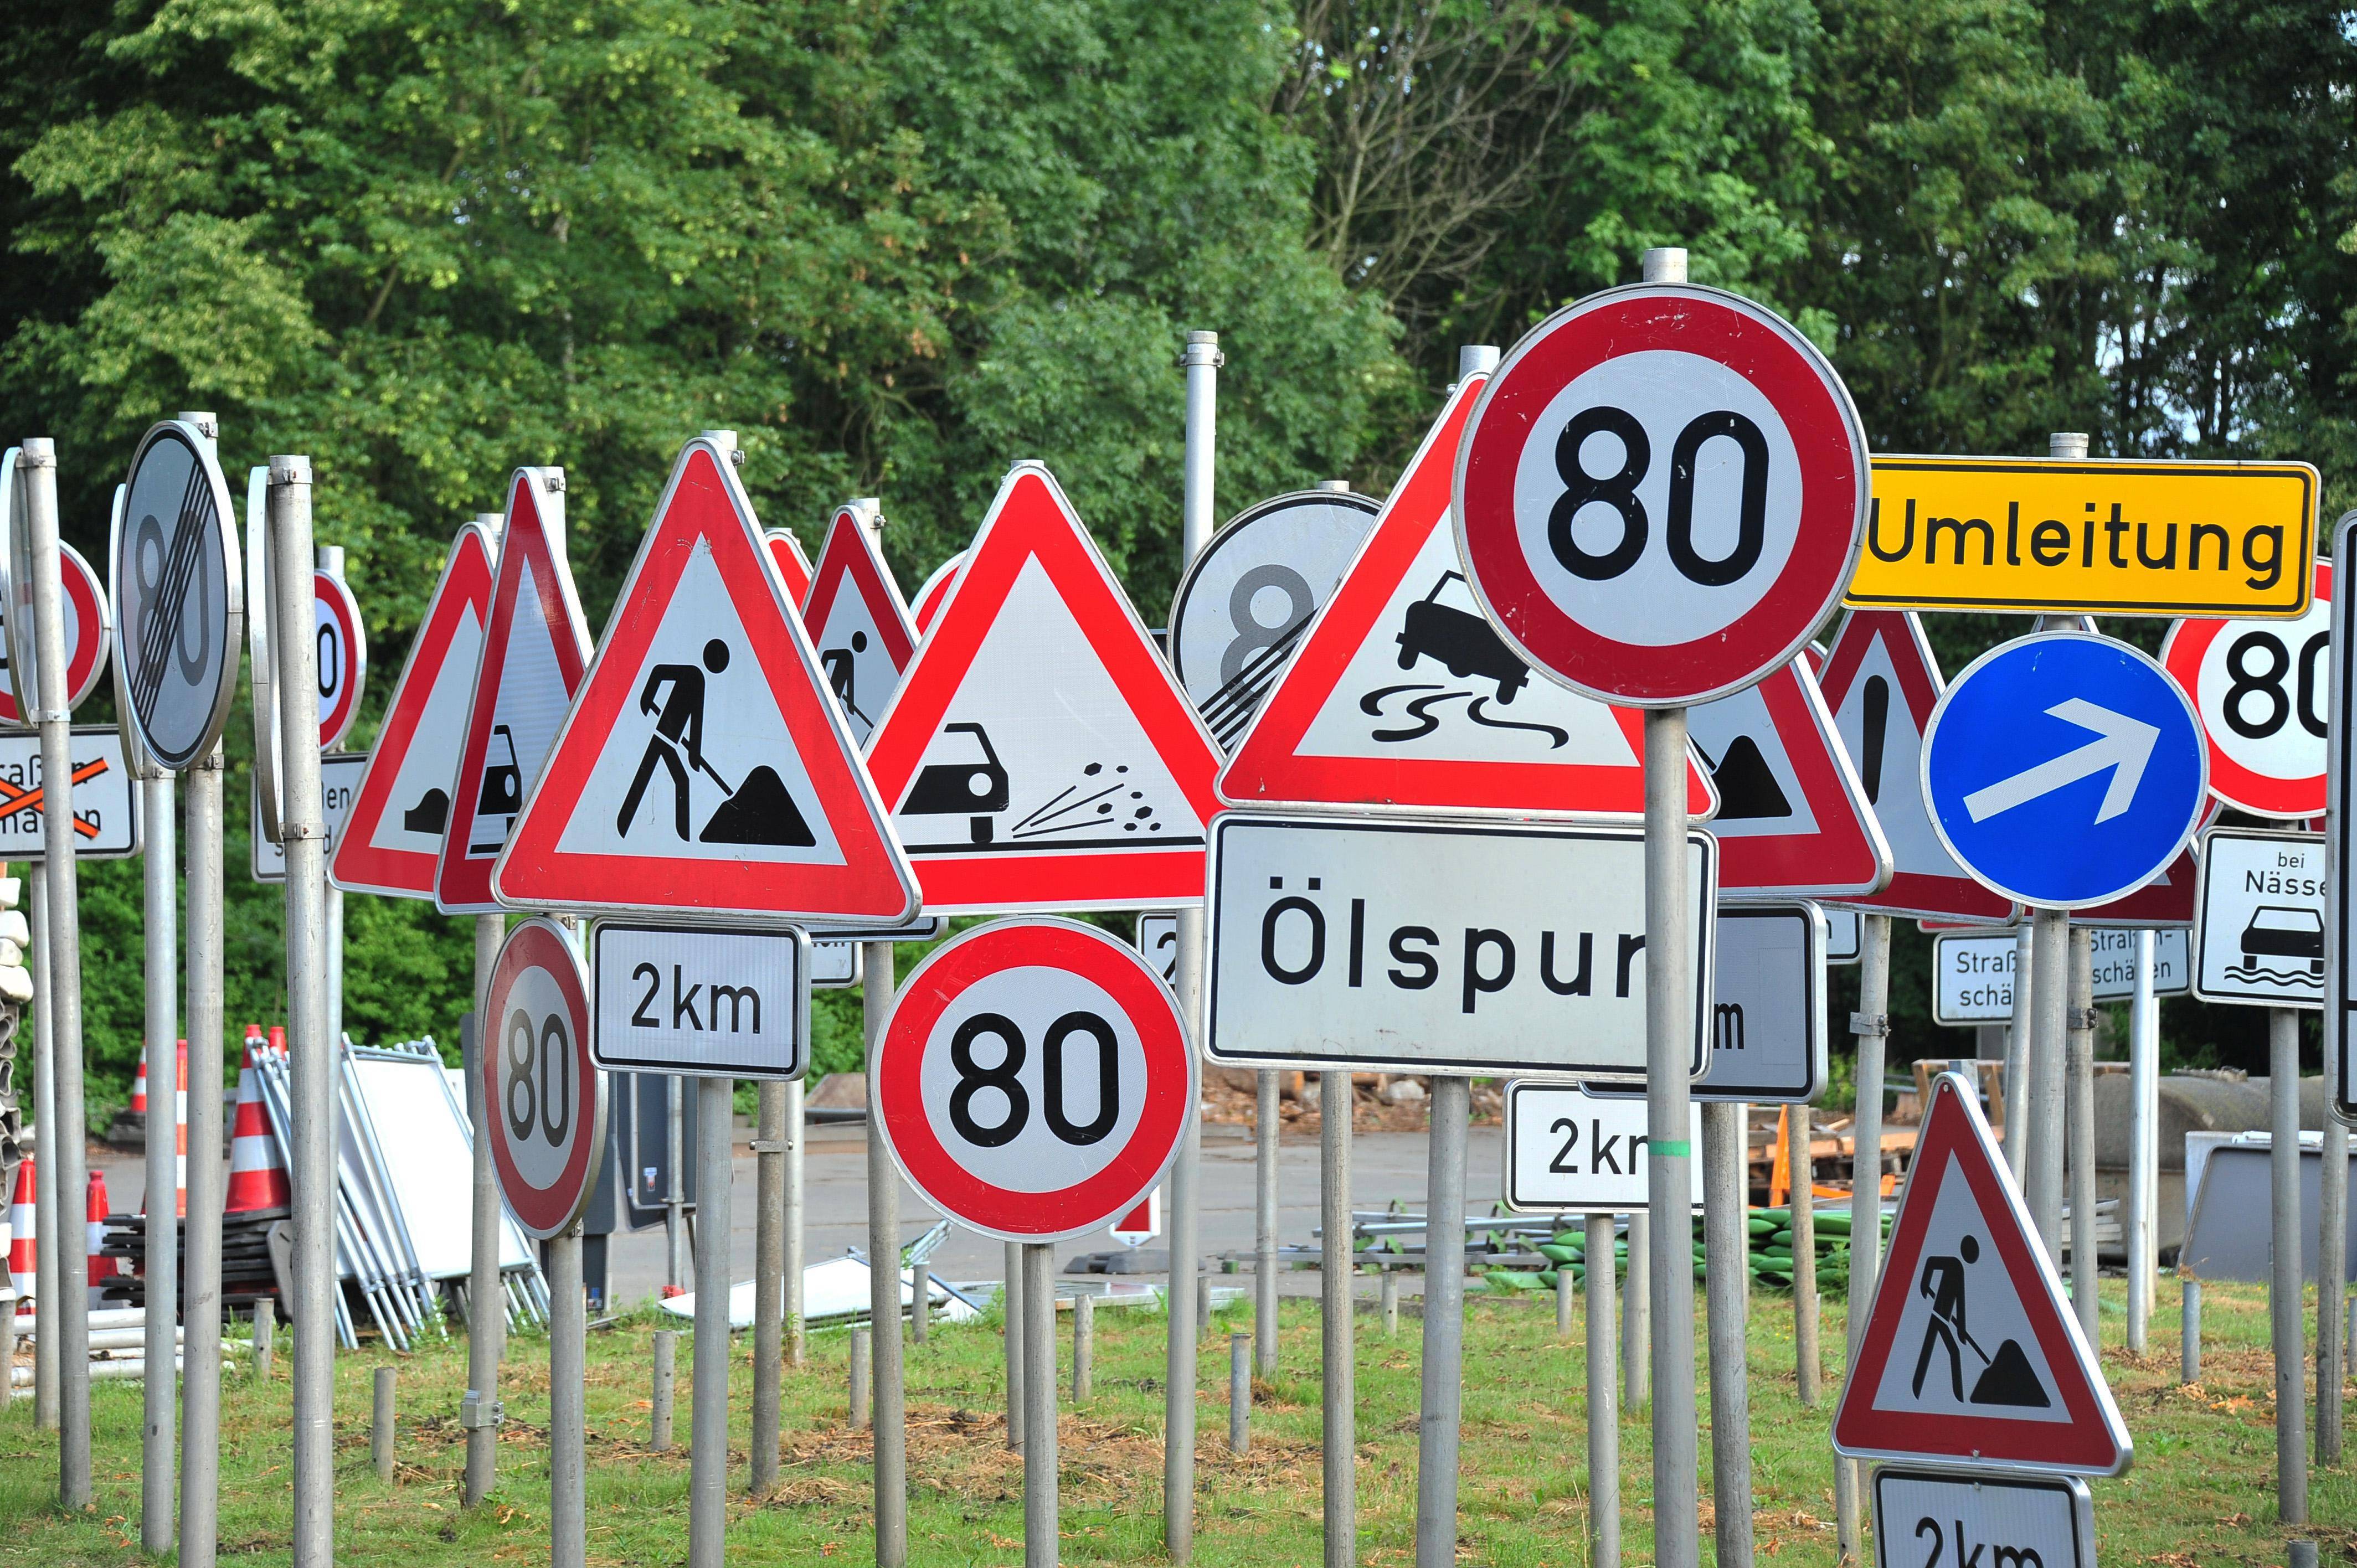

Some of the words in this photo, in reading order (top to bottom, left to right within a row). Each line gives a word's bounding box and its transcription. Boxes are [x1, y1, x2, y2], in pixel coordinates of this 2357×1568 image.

[1547, 406, 1769, 586] 80
[1868, 498, 2284, 590] Umleitung
[136, 509, 210, 687] 80
[2223, 631, 2330, 739] 80
[2278, 852, 2305, 869] bei
[631, 962, 661, 1028] 2
[673, 964, 761, 1035] km
[1261, 876, 1646, 1014] Ölspur
[507, 1008, 569, 1148] 80
[949, 1010, 1119, 1148] 80
[1550, 1117, 1578, 1174] 2
[1915, 1517, 1944, 1568] 2
